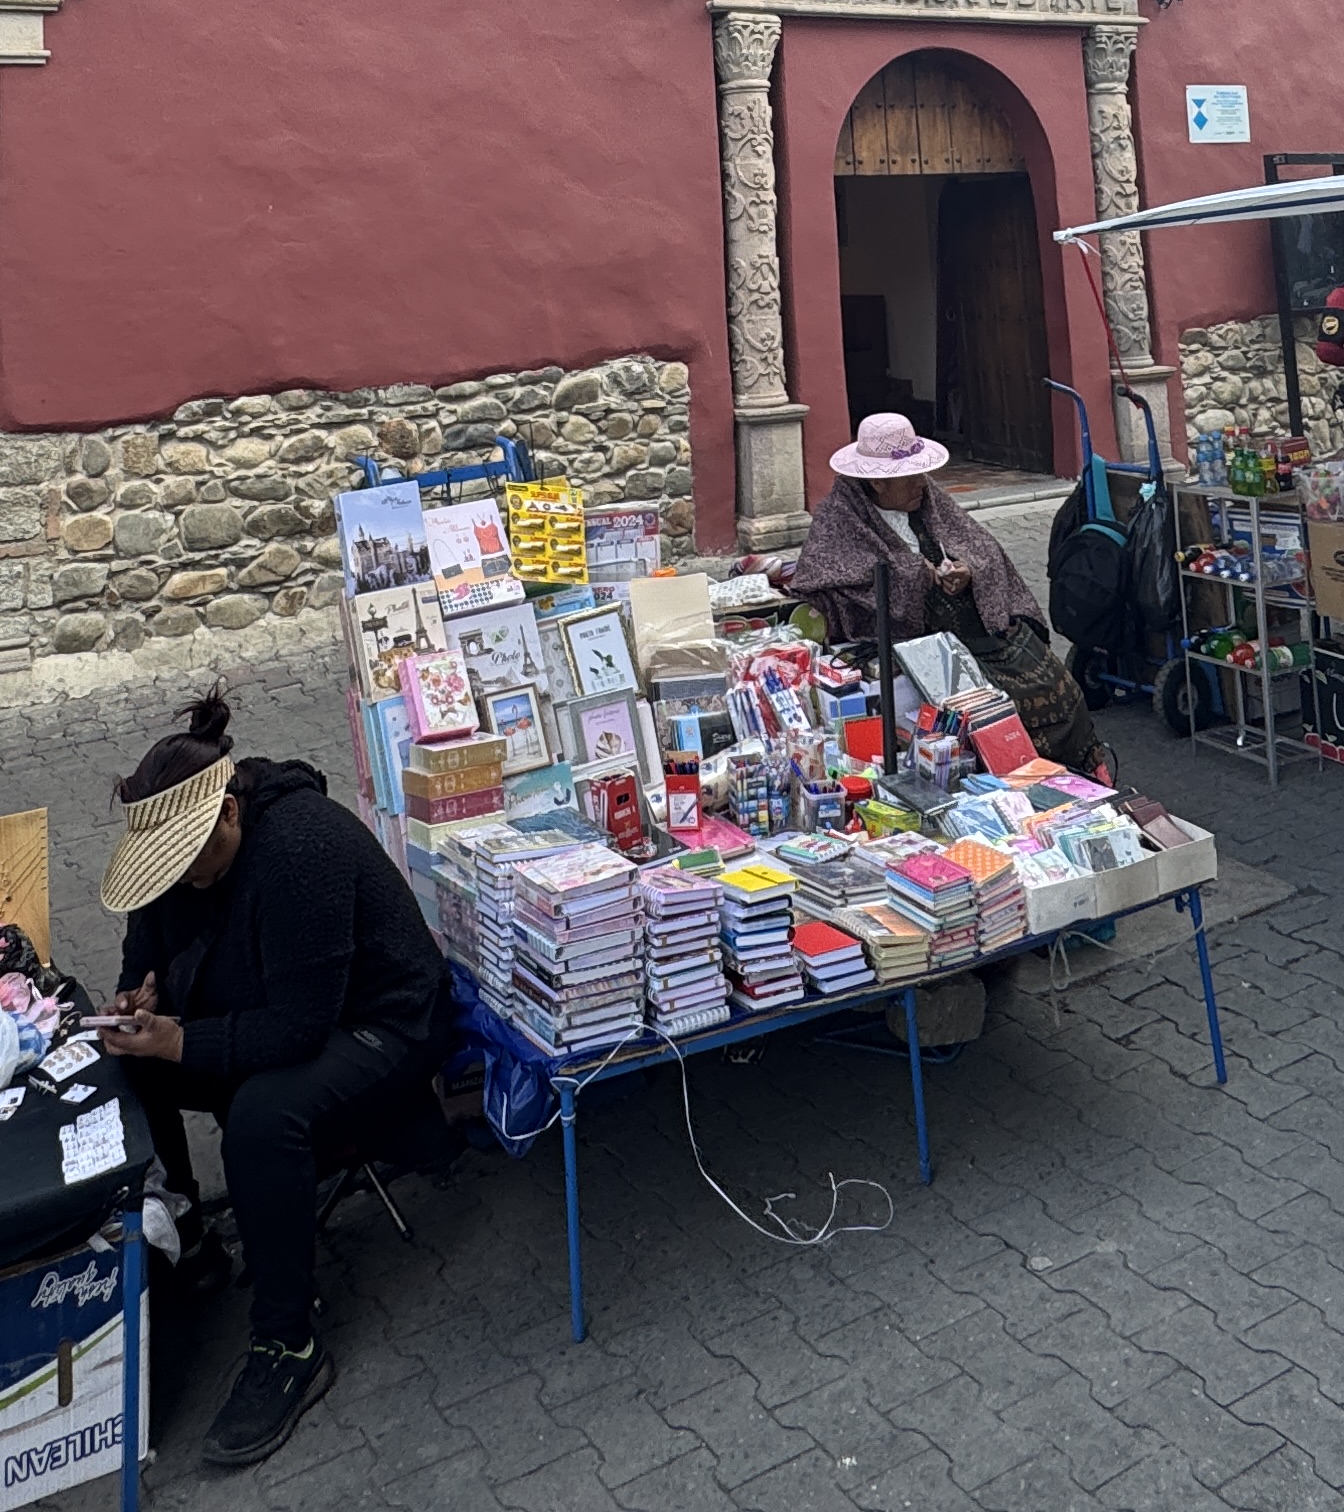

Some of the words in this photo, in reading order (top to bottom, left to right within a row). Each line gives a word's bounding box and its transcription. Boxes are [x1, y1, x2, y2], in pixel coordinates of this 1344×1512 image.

[612, 514, 644, 528] 2024
[490, 649, 522, 667] Photo
[30, 1260, 97, 1309] quality
[76, 1266, 119, 1306] fresh
